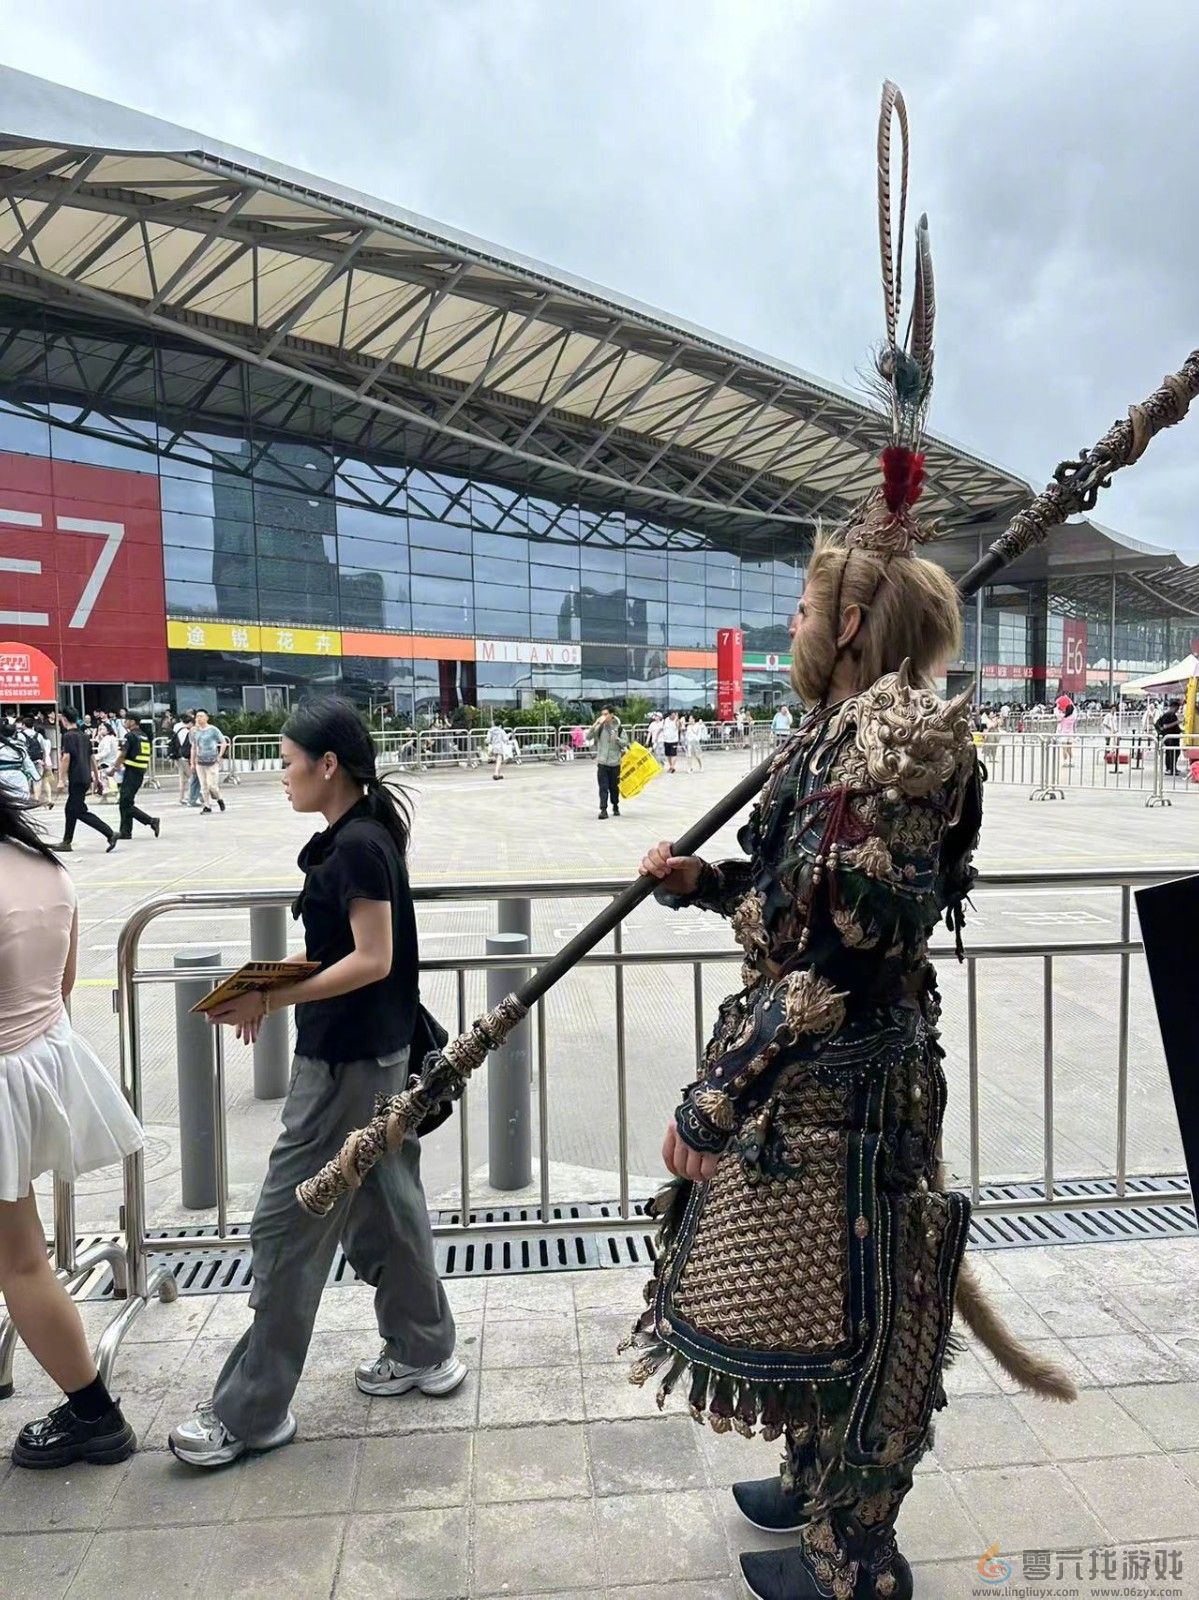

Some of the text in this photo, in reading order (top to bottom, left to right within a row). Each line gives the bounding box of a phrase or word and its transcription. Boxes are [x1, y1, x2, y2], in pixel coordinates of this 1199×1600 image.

[0, 508, 125, 629] E7
[482, 642, 570, 663] MILANO
[1066, 637, 1083, 675] E6
